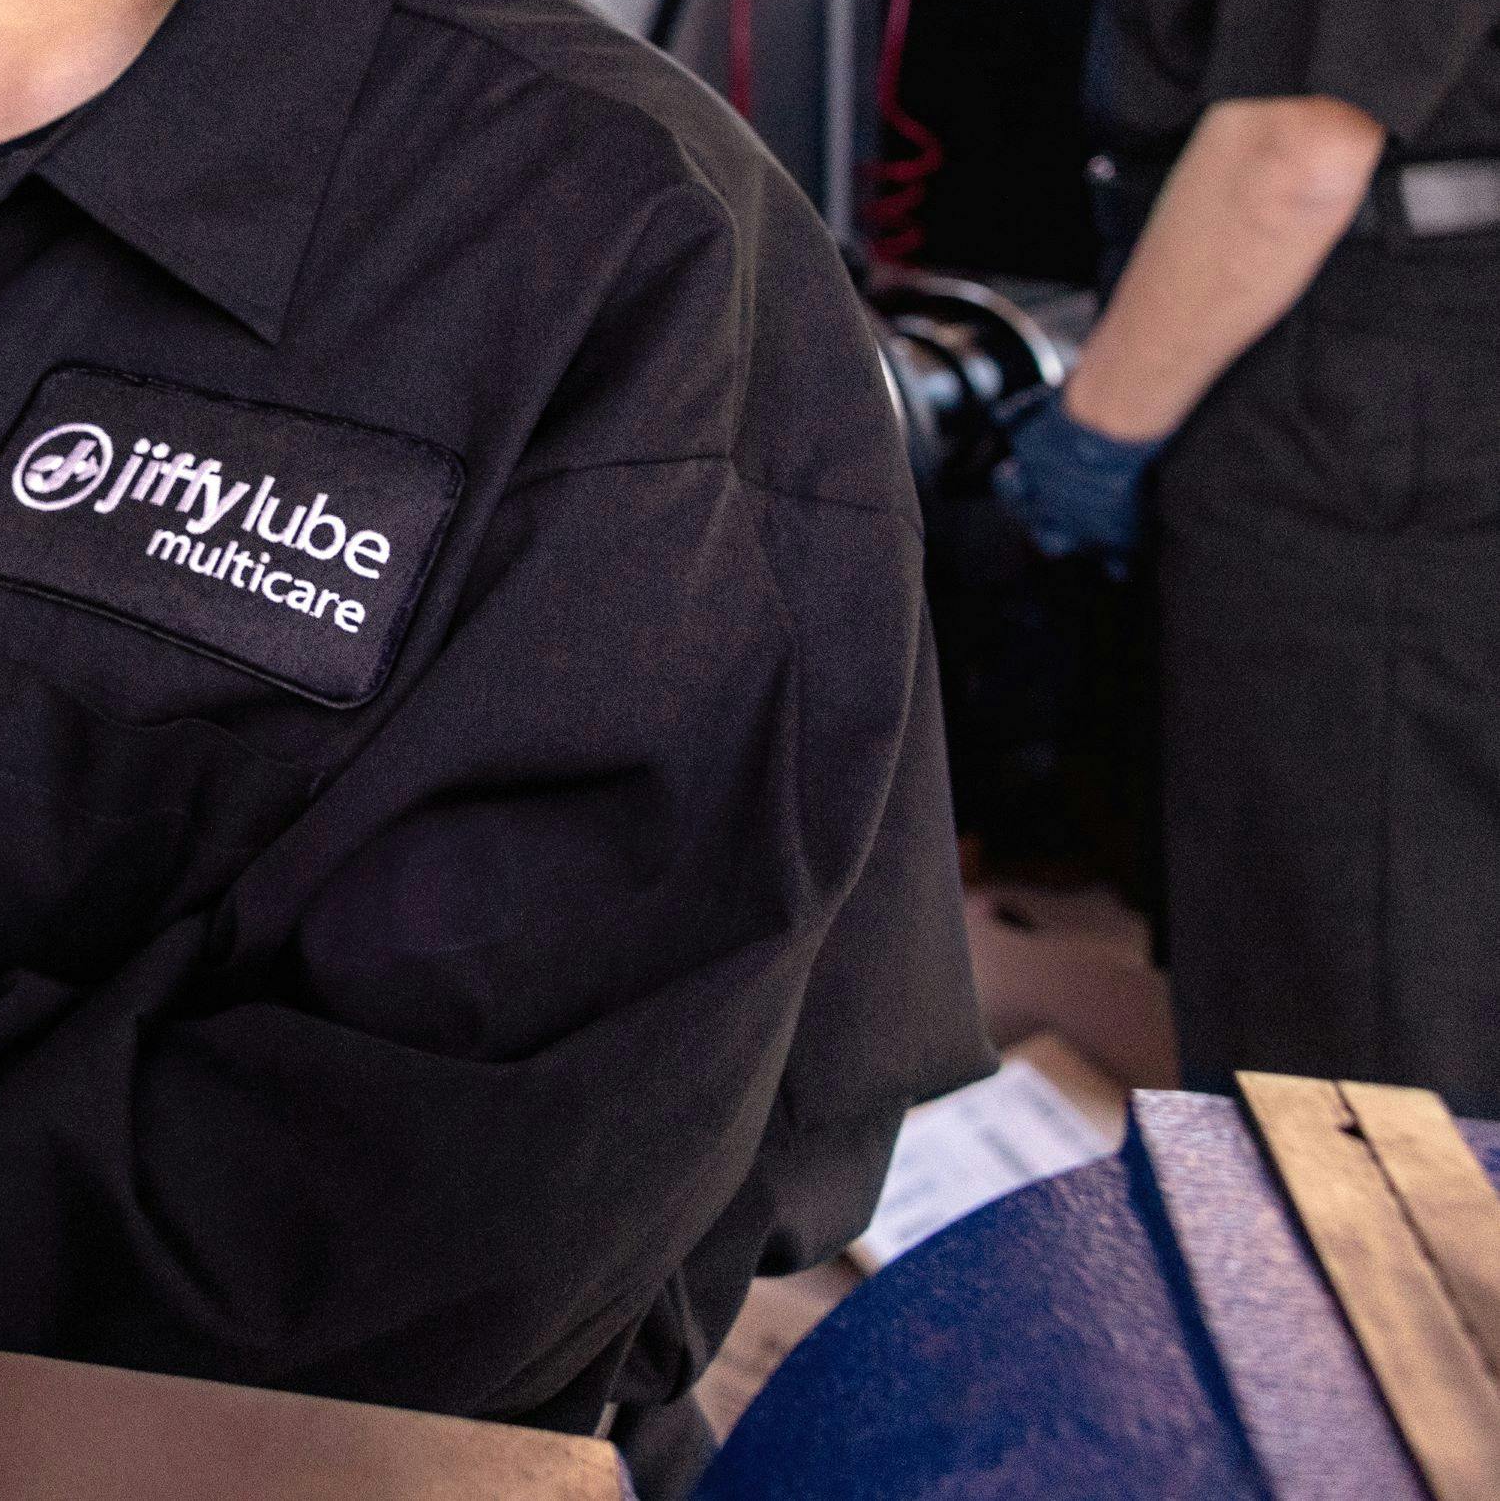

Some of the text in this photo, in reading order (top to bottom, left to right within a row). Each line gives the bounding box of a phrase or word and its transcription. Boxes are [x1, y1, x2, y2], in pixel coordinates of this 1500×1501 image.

[94, 437, 391, 579] jiffy lube
[145, 528, 366, 634] multicare
